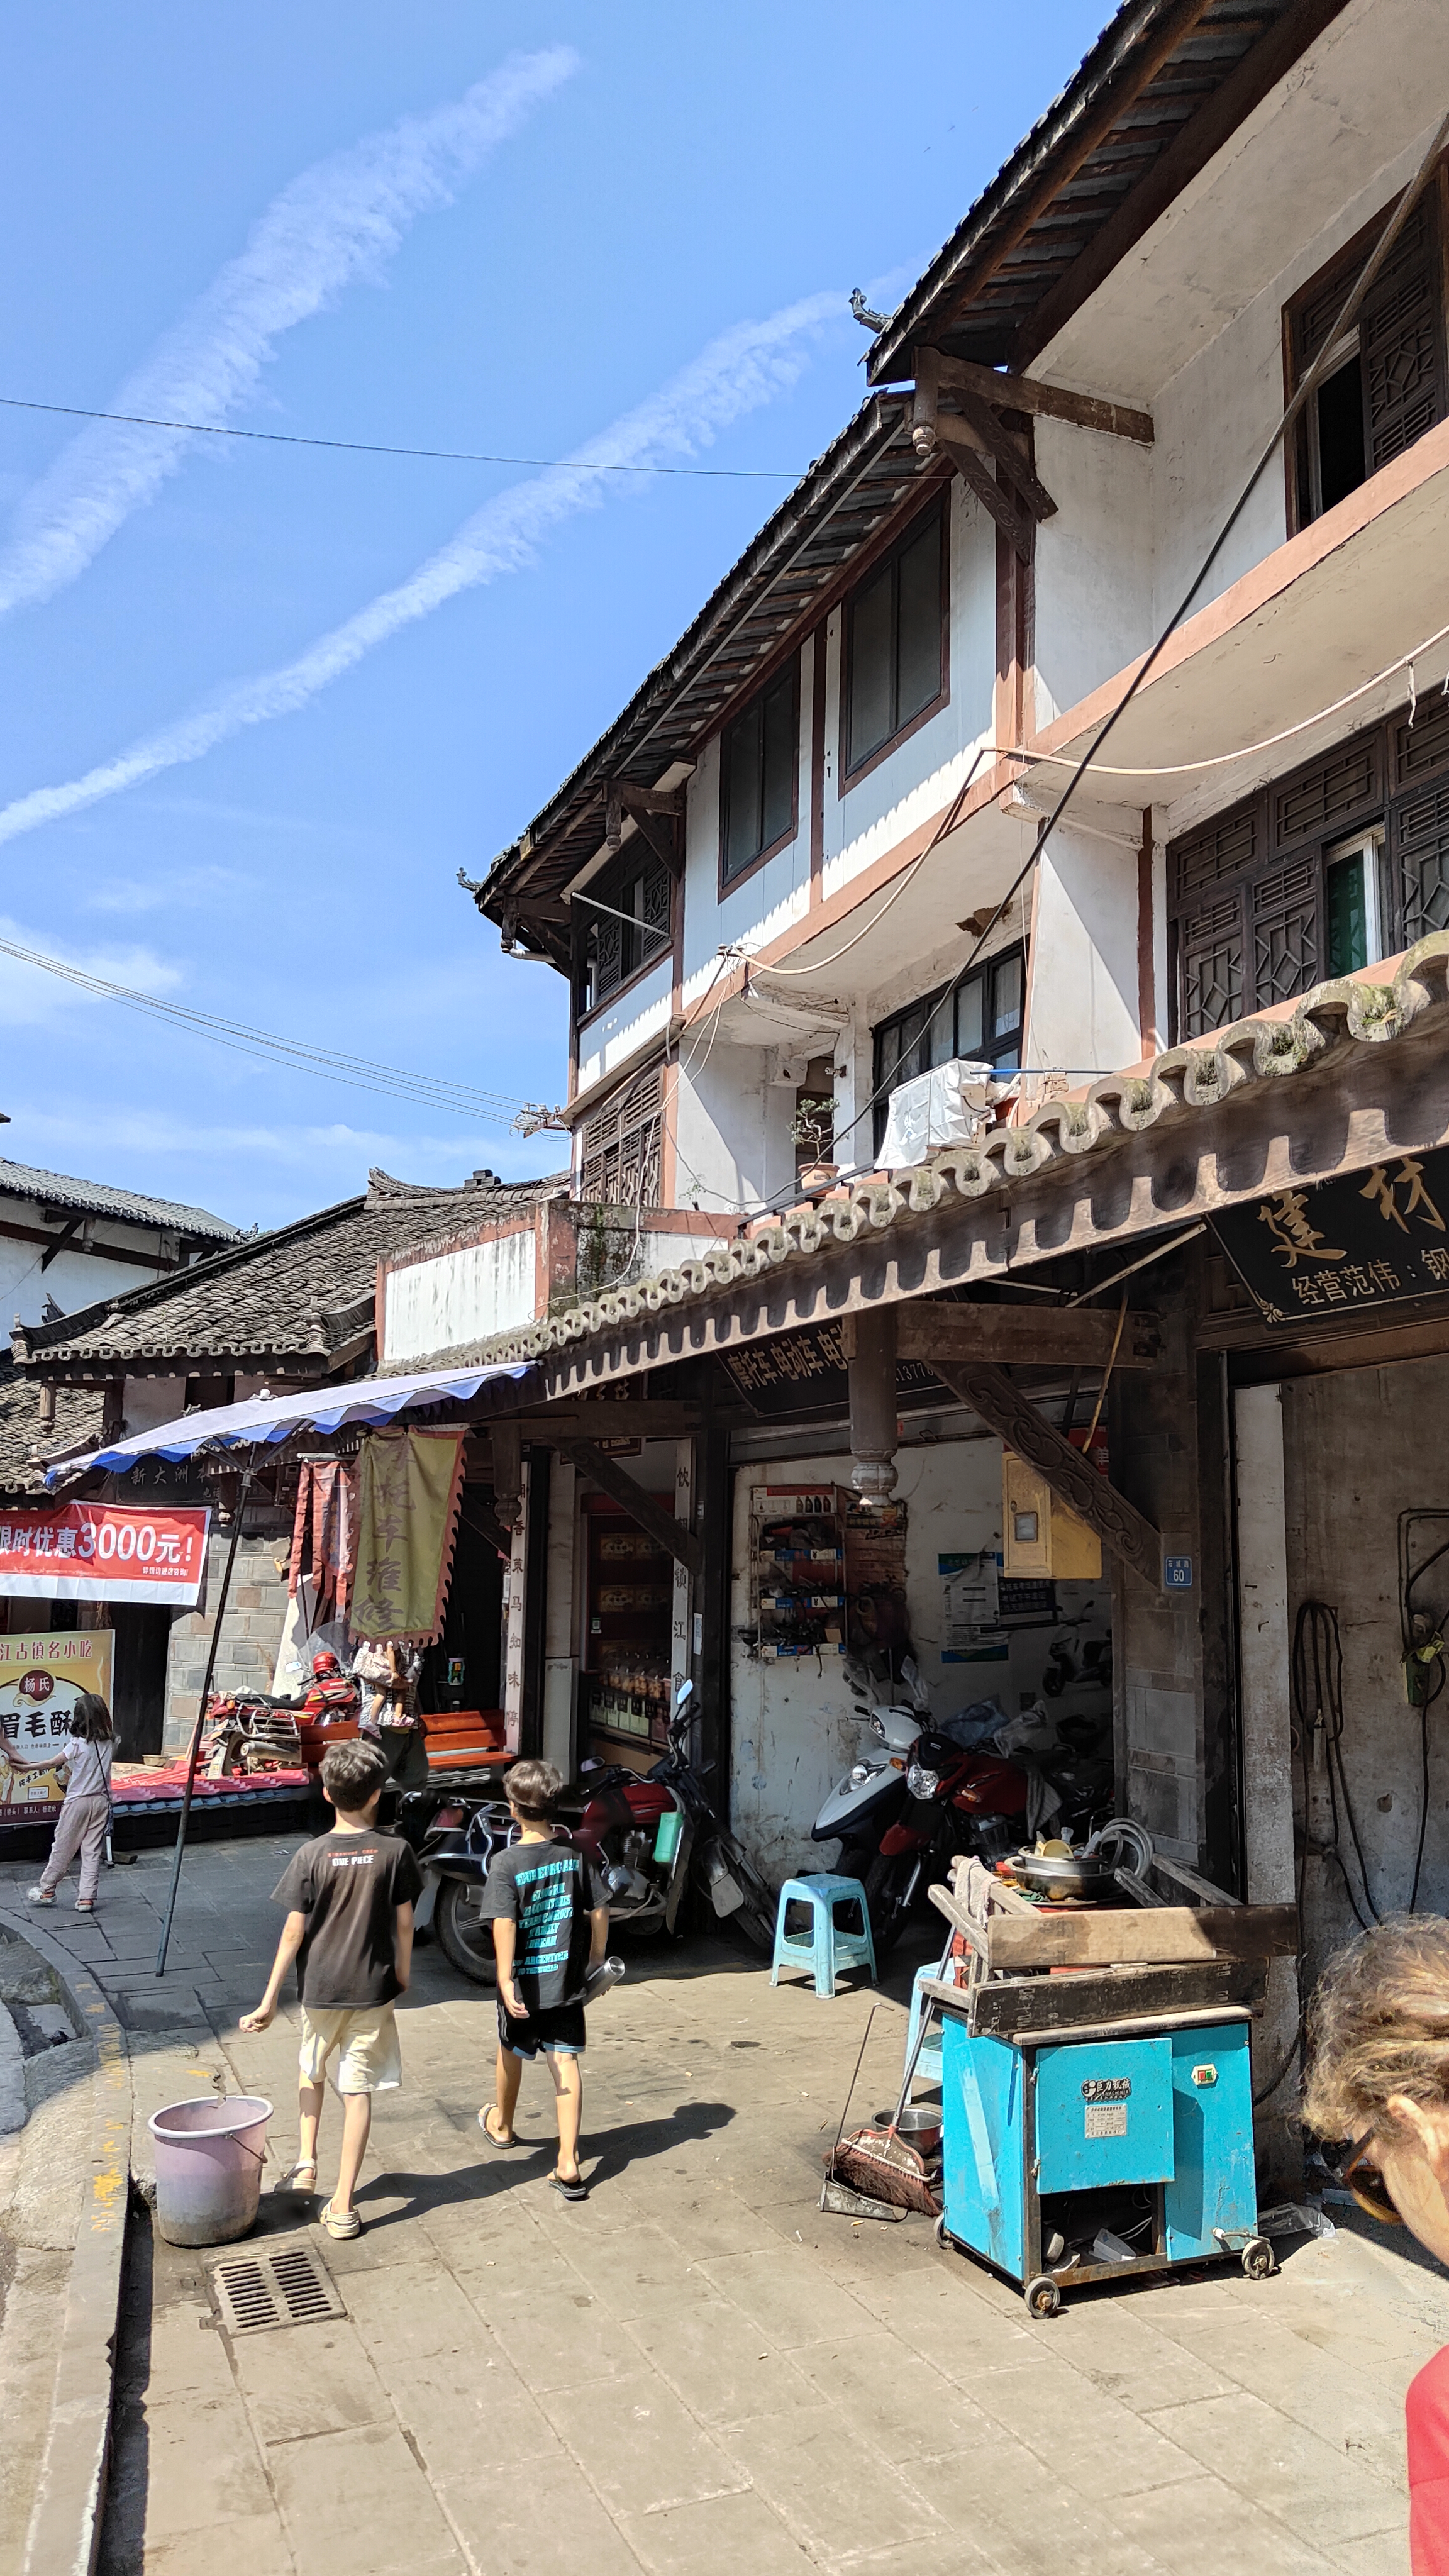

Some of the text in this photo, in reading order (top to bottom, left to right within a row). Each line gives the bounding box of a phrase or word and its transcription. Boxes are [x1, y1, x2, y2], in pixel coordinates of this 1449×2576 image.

[1173, 1569, 1184, 1582] 60
[0, 1640, 93, 1661] 江古镇名小吃
[24, 1676, 50, 1693] 杨氏
[332, 1855, 374, 1867] ONE PIECE
